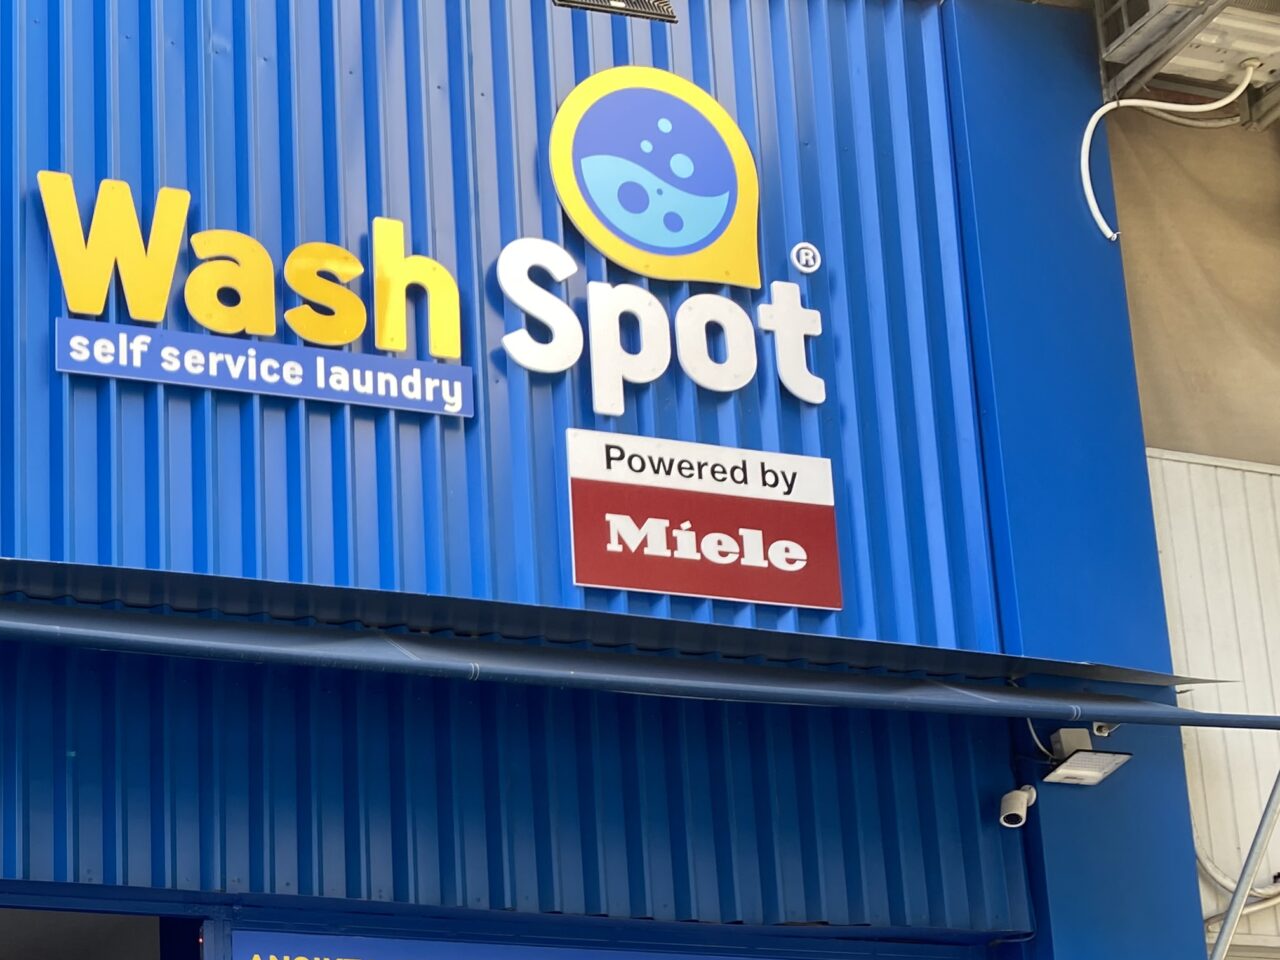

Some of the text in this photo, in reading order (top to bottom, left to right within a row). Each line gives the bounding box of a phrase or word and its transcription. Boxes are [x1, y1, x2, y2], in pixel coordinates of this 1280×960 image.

[37, 169, 462, 359] Wash
[496, 237, 826, 416] Spot
[69, 332, 462, 412] self service laundry
[604, 443, 797, 496] Powered by
[605, 512, 808, 572] Miele
